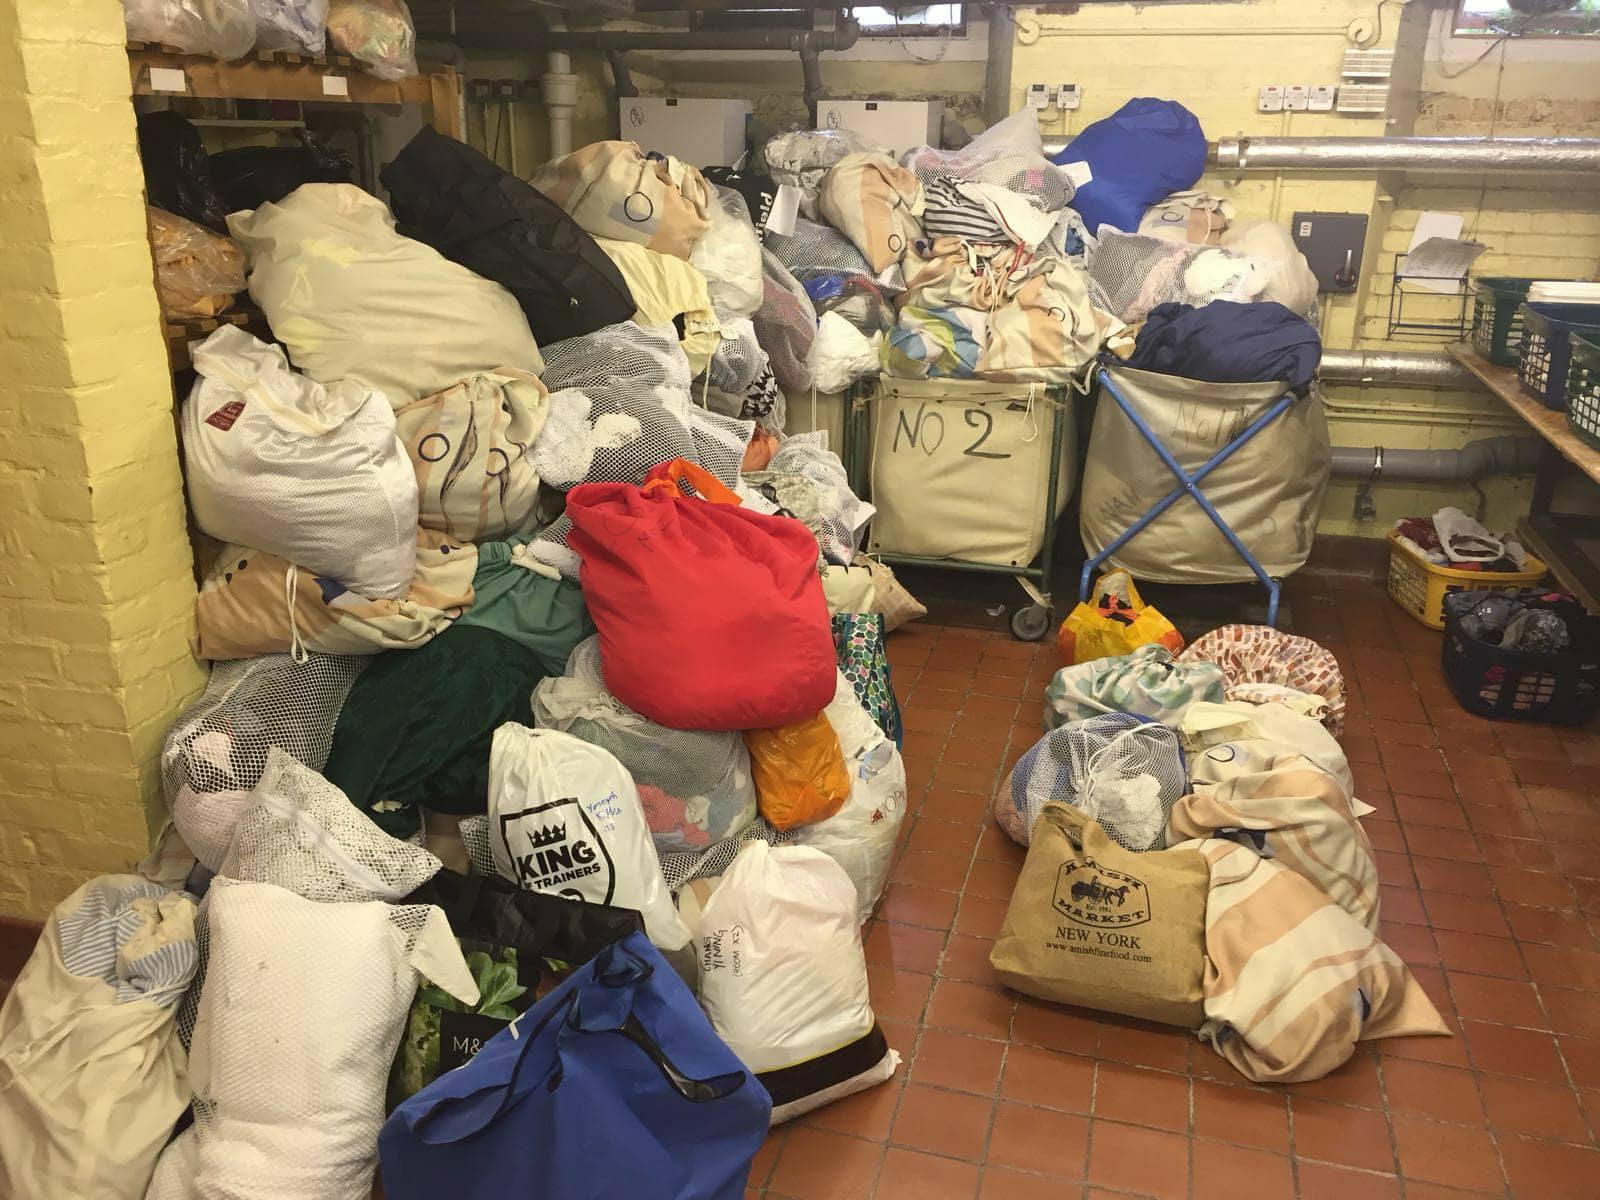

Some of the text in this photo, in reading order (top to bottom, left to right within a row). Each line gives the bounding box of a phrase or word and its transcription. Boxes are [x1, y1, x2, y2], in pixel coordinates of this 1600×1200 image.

[893, 402, 1012, 459] NO 2
[516, 840, 596, 881] KING
[534, 863, 601, 890] TRAINERS
[1058, 898, 1145, 922] MARKET
[1055, 926, 1141, 949] NEW YORK
[1046, 941, 1152, 963] www.amishfinefood.com
[453, 1036, 486, 1056] M&
